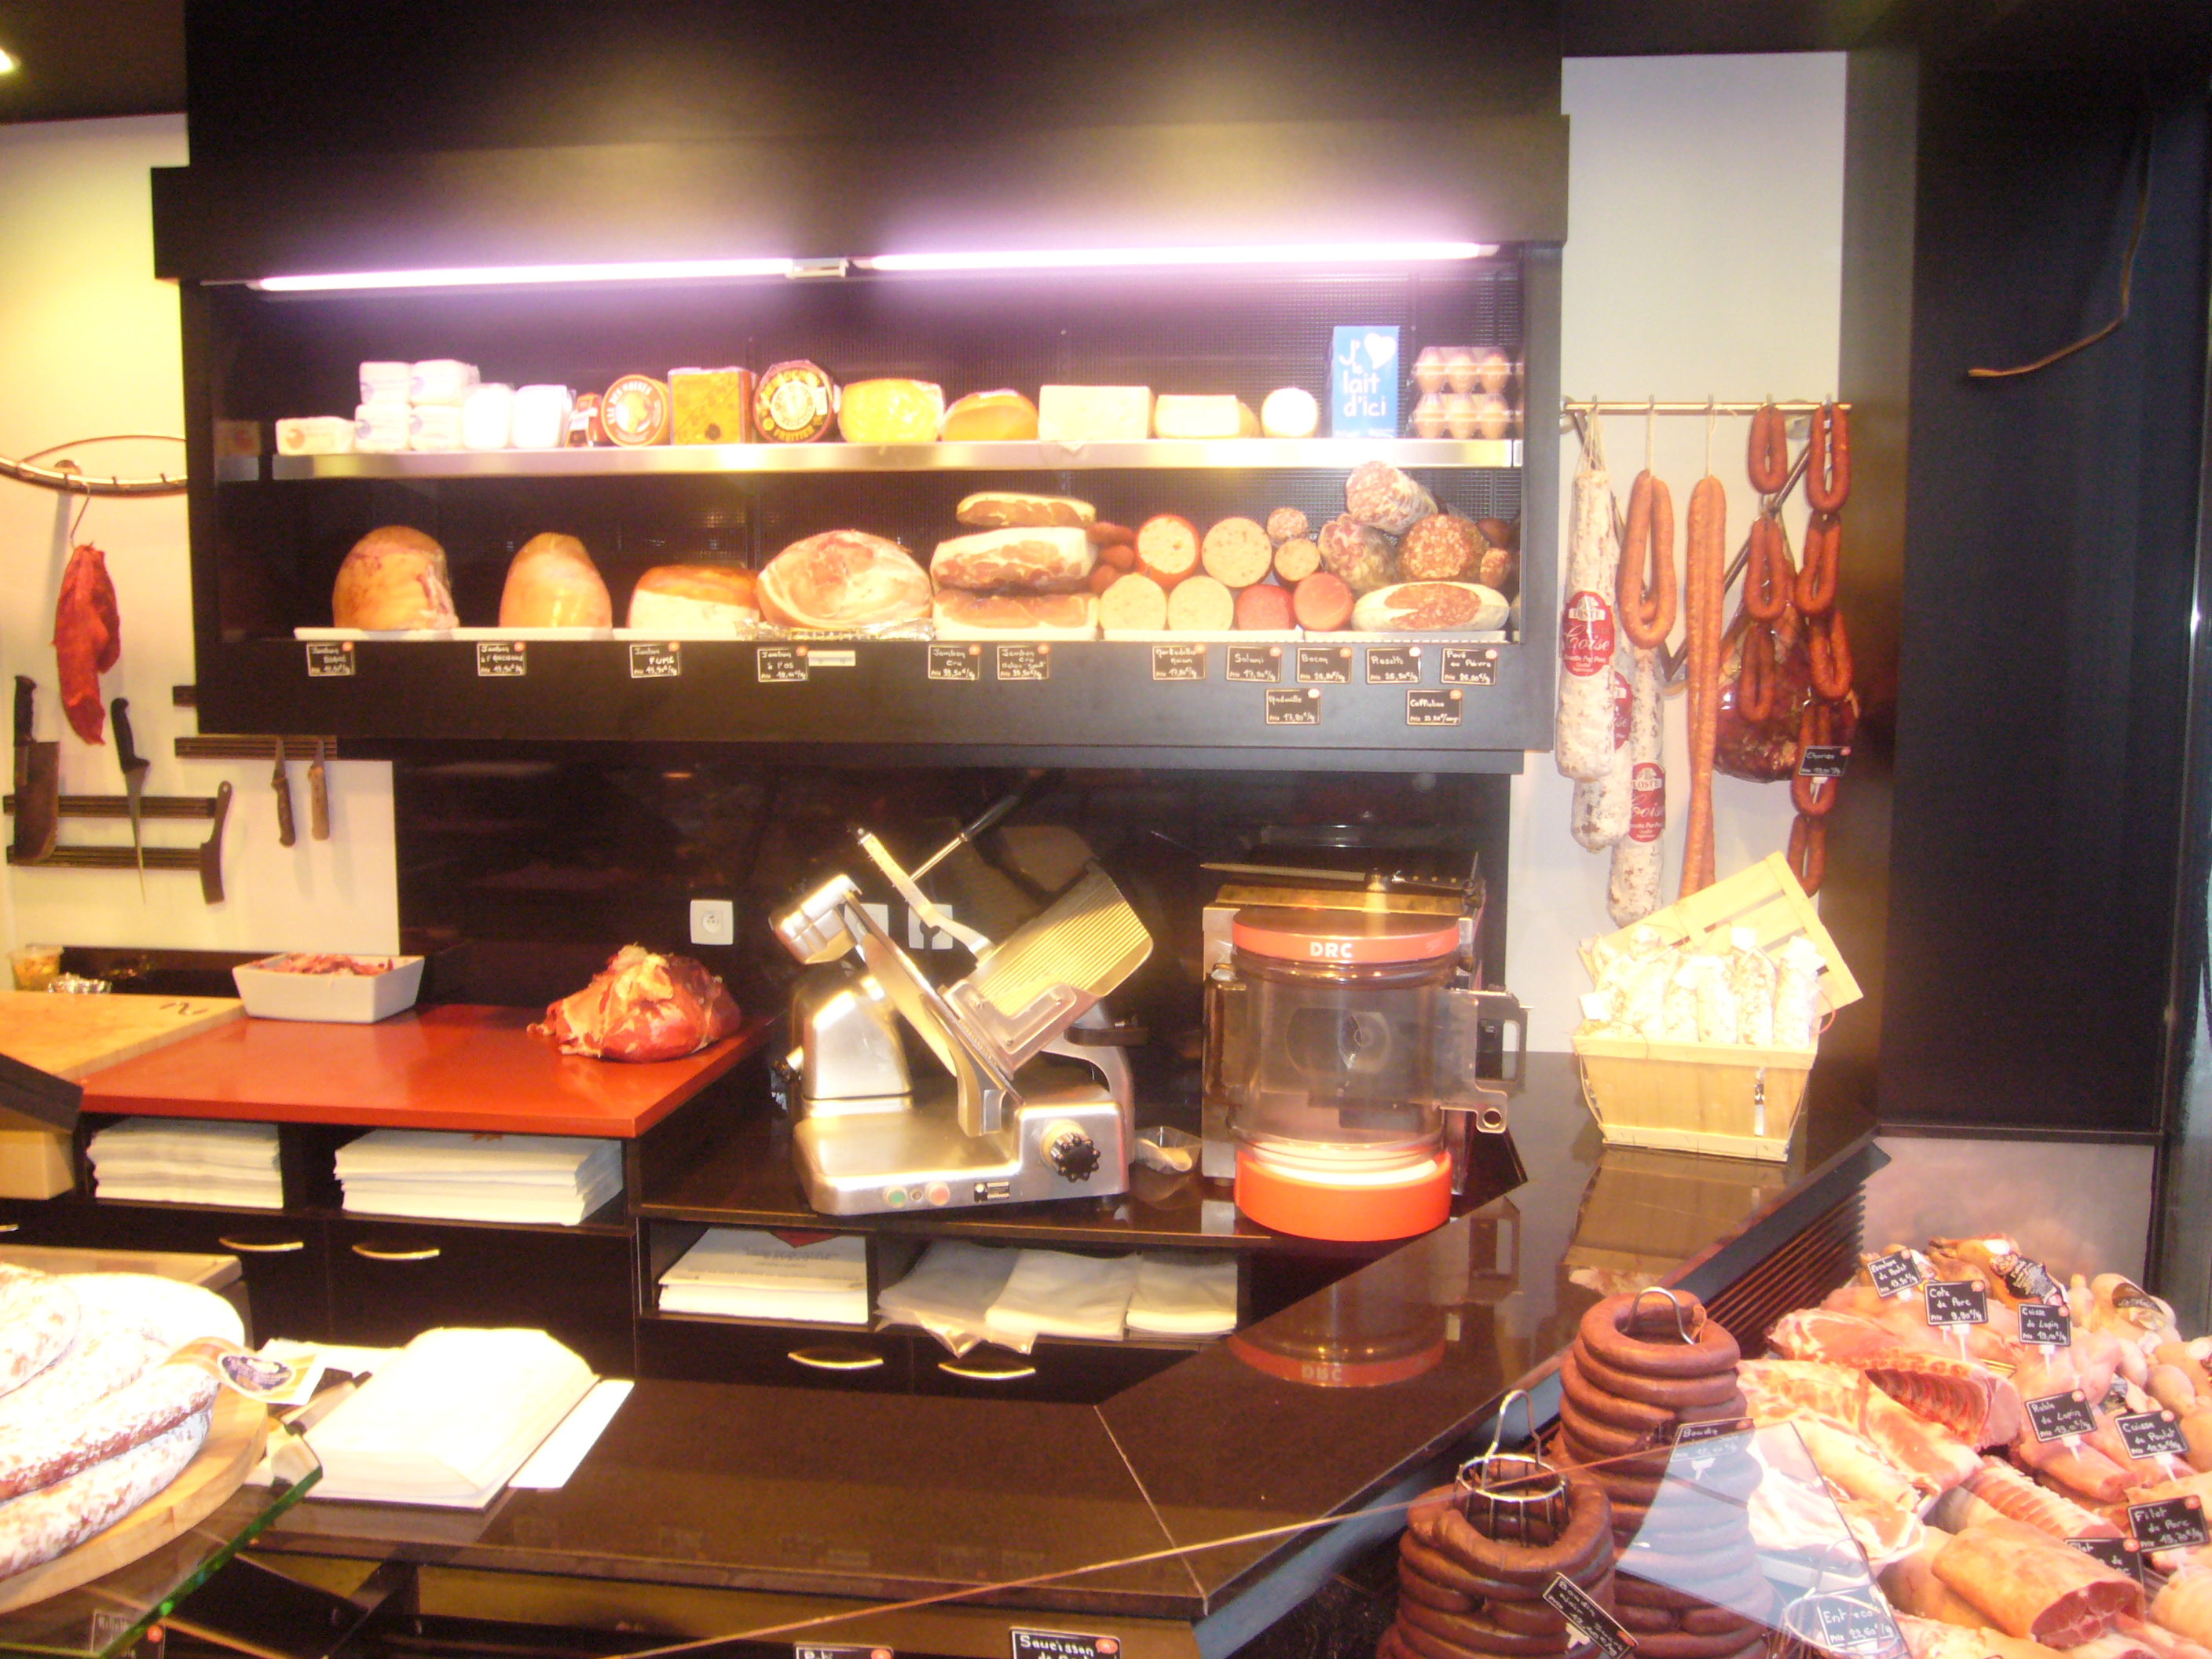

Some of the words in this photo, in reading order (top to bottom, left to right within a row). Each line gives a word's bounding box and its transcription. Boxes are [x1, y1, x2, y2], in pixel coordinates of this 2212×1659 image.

[1339, 339, 1361, 366] J'
[1343, 369, 1381, 394] lait
[1343, 394, 1386, 417] d'ici
[932, 648, 966, 659] Jambon
[1002, 648, 1035, 657] Jambon
[1234, 653, 1265, 664] Salami
[1301, 654, 1328, 665] Bacon
[1370, 655, 1404, 665] Rosette
[1309, 941, 1353, 958] DRC
[1937, 1299, 1947, 1308] de
[1951, 1296, 1972, 1307] Porc
[2021, 1307, 2046, 1317] Cuisse
[2026, 1319, 2035, 1328] de
[2038, 1319, 2060, 1330] Lapin
[2041, 1415, 2052, 1424] de
[2056, 1409, 2082, 1422] Lapin
[2122, 1421, 2155, 1433] Cuisse
[2134, 1436, 2145, 1445] de
[2147, 1427, 2176, 1442] Poulet
[2133, 1507, 2168, 1522] Filet
[2147, 1522, 2161, 1533] de
[1020, 1634, 1095, 1658] Saucisson
